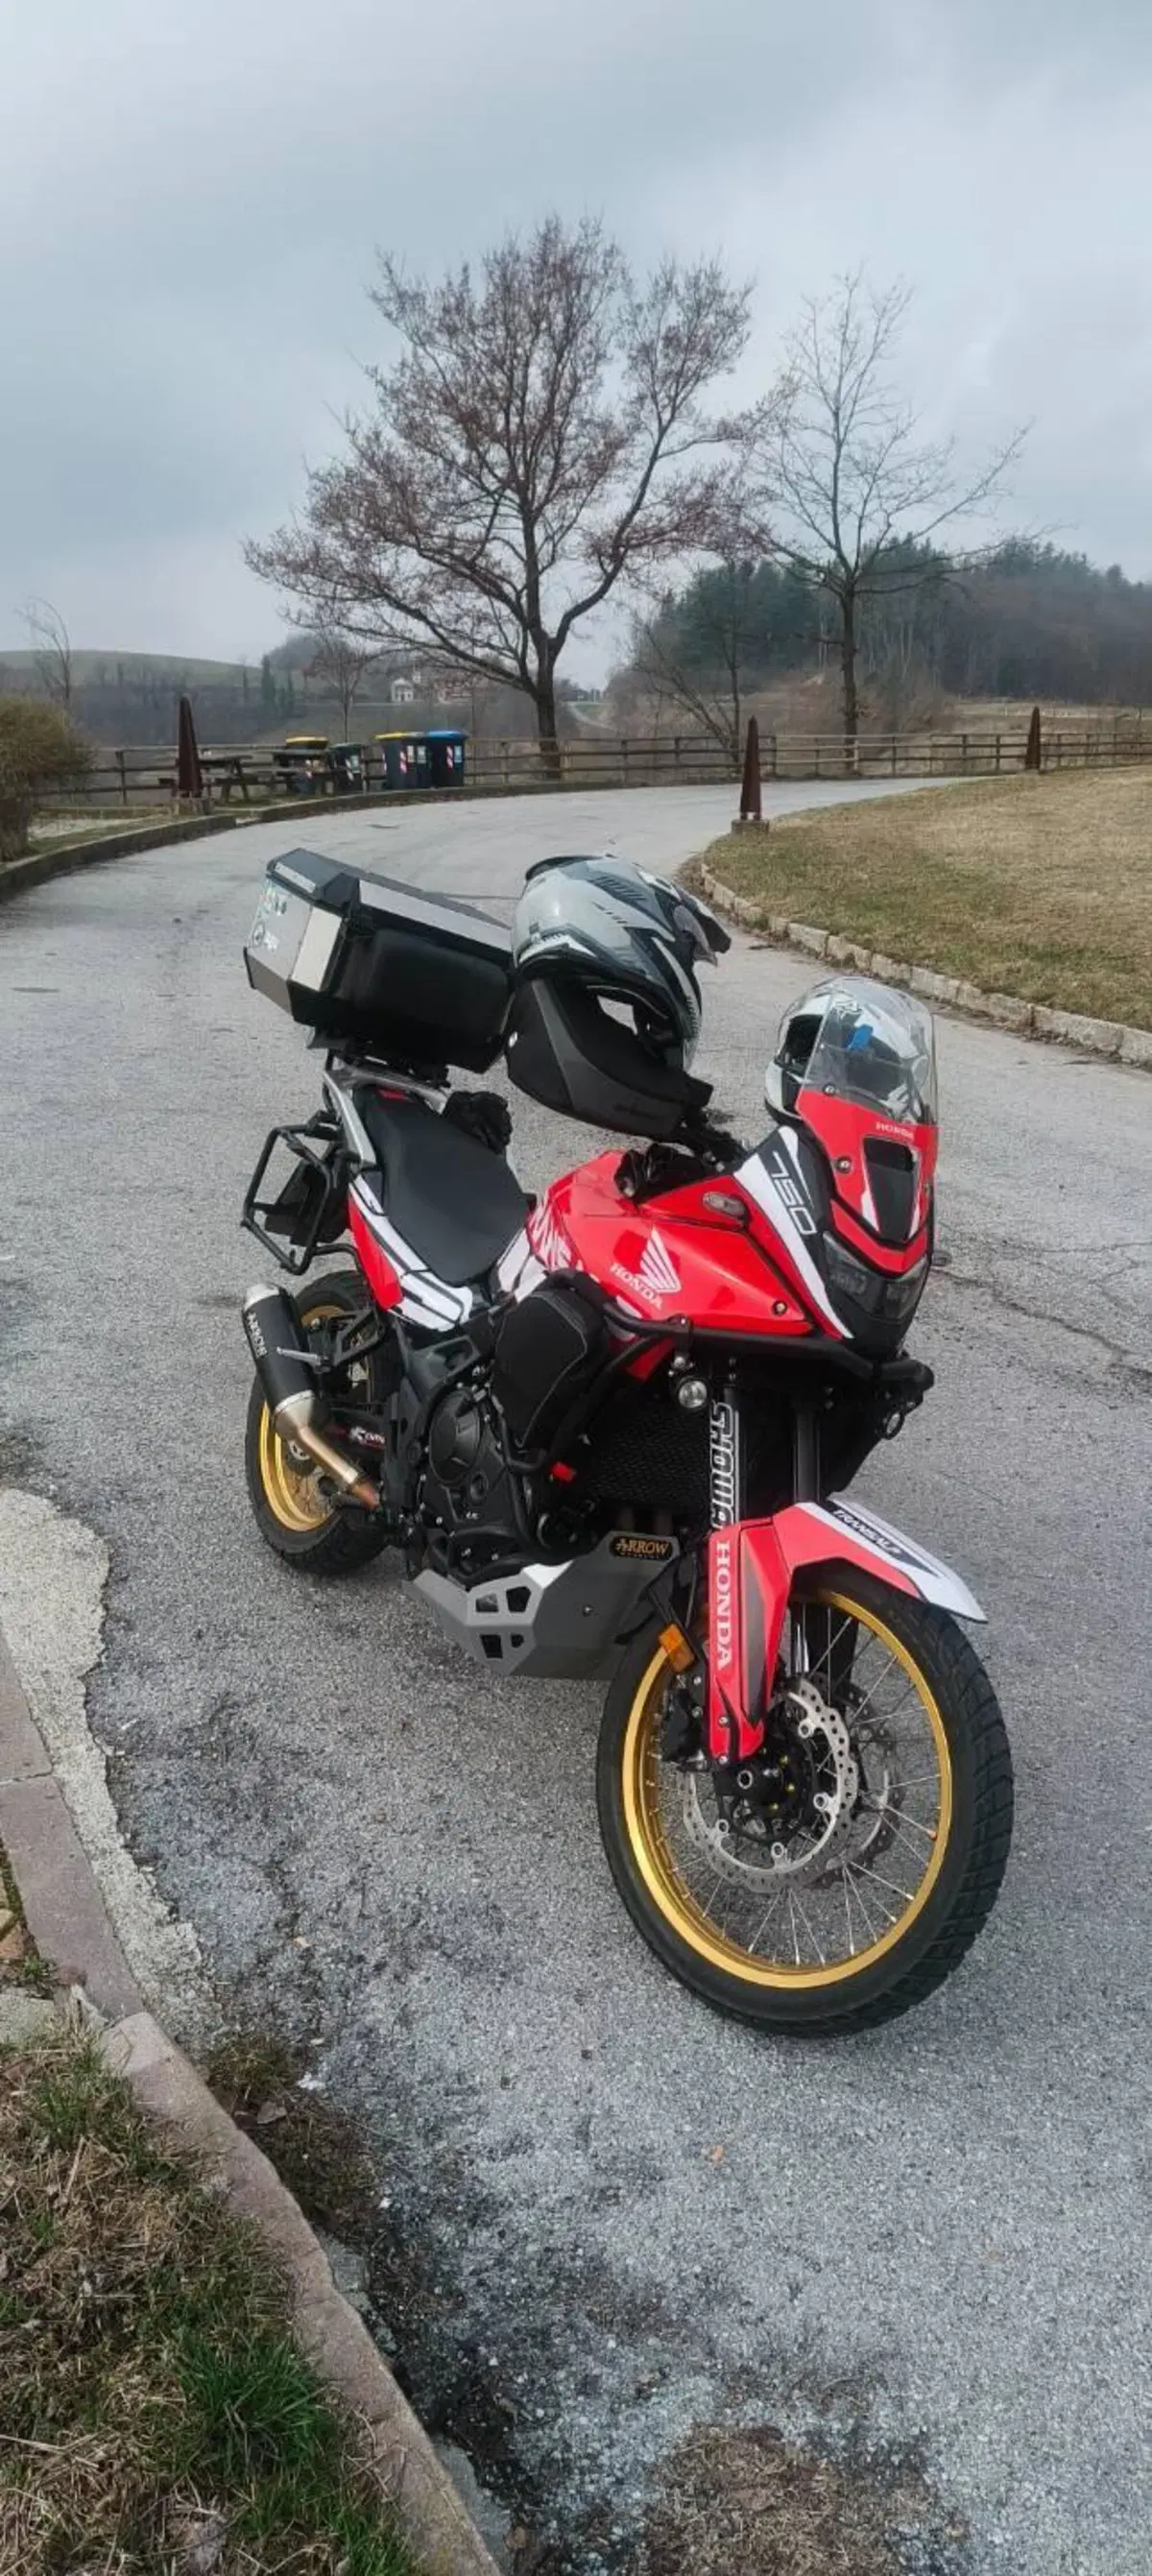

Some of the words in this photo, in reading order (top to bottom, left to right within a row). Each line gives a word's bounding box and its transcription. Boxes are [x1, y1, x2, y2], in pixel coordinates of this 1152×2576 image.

[771, 1150, 818, 1236] 750
[609, 1261, 662, 1311] HONDA
[710, 1399, 734, 1530] SHOWA
[615, 1538, 669, 1556] ARROW
[716, 1540, 732, 1672] HONDA
